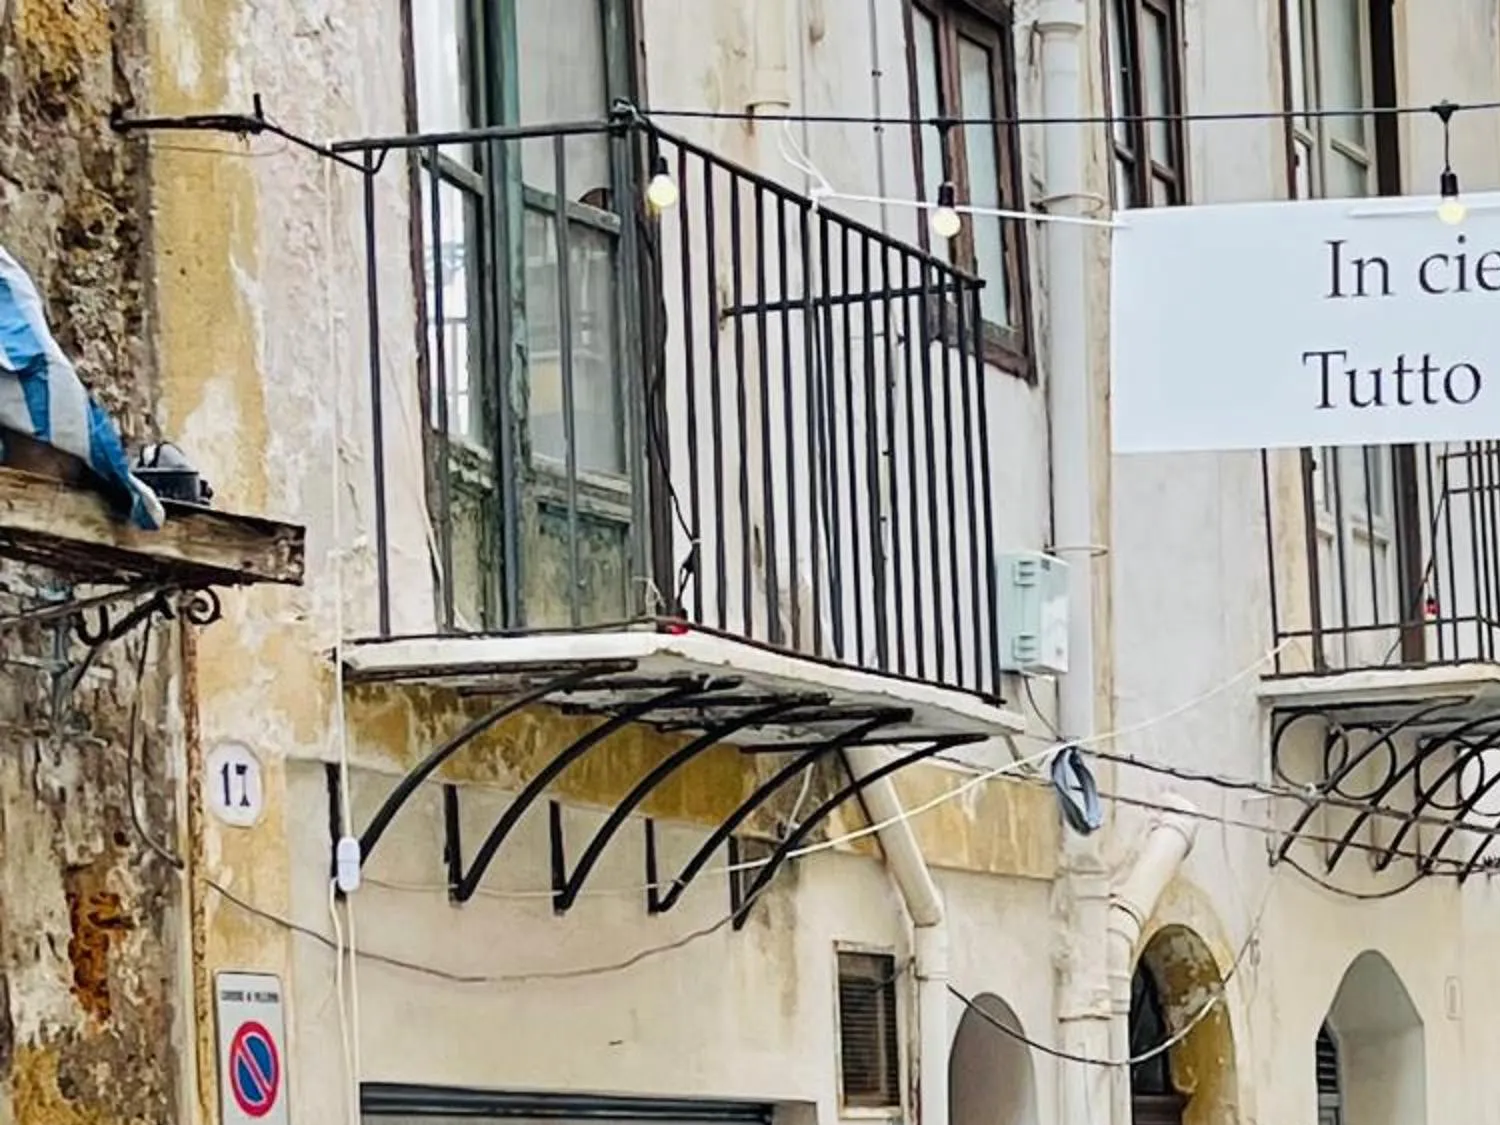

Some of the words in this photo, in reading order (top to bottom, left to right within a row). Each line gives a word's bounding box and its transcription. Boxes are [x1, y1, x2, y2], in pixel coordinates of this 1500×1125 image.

[1324, 239, 1394, 299] In
[1302, 350, 1482, 410] Tutto
[220, 761, 251, 807] 17
